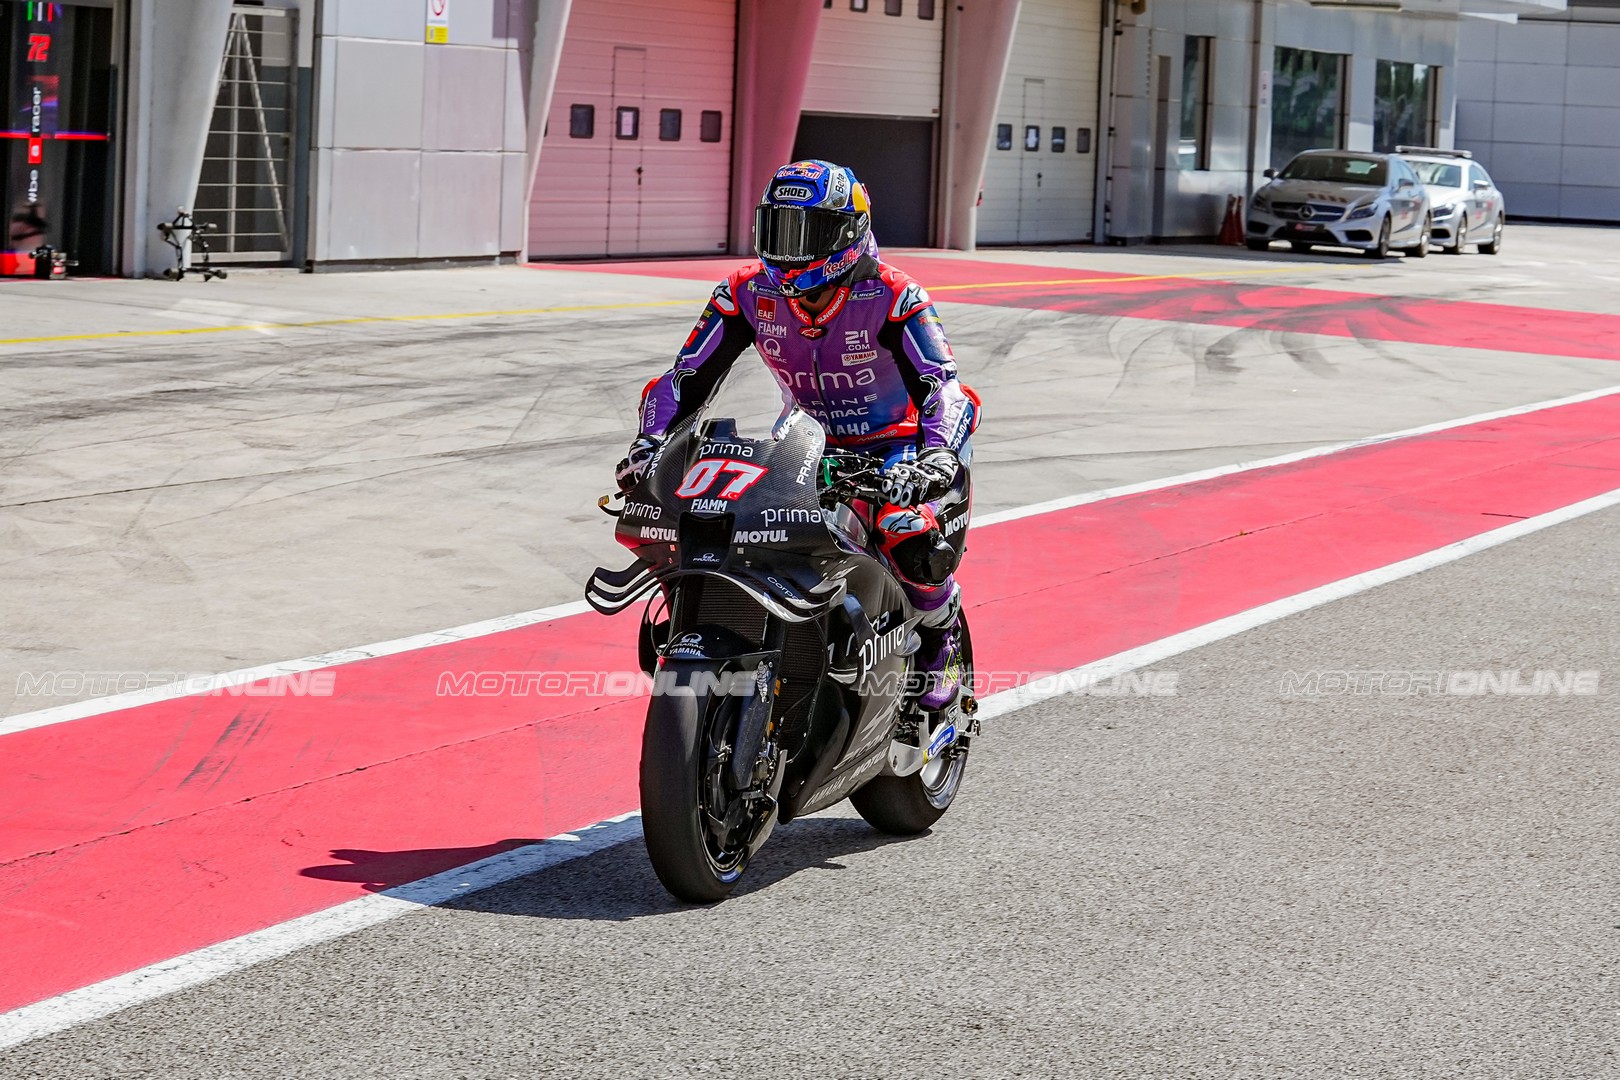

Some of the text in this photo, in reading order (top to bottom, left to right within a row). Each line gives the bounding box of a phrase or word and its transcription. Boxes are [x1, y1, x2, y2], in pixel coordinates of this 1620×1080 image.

[27, 33, 51, 62] 72
[32, 87, 42, 133] racer
[835, 173, 846, 194] Beta
[777, 187, 808, 198] SHOEI
[784, 253, 815, 262] Otomotiv
[822, 253, 847, 277] Red
[757, 309, 774, 320] EAE
[758, 322, 787, 336] FIAMM
[849, 351, 876, 361] YAMAHA
[698, 443, 754, 459] prima
[795, 438, 823, 486] PRAMAC
[675, 458, 769, 500] 07
[622, 500, 662, 520] prima
[690, 499, 728, 512] FIAMM
[760, 508, 822, 527] prima
[944, 510, 969, 538] MOTU
[640, 526, 678, 542] MOTUL
[733, 530, 789, 543] MOTUL
[669, 647, 702, 657] YAMAHA
[858, 623, 905, 685] prima
